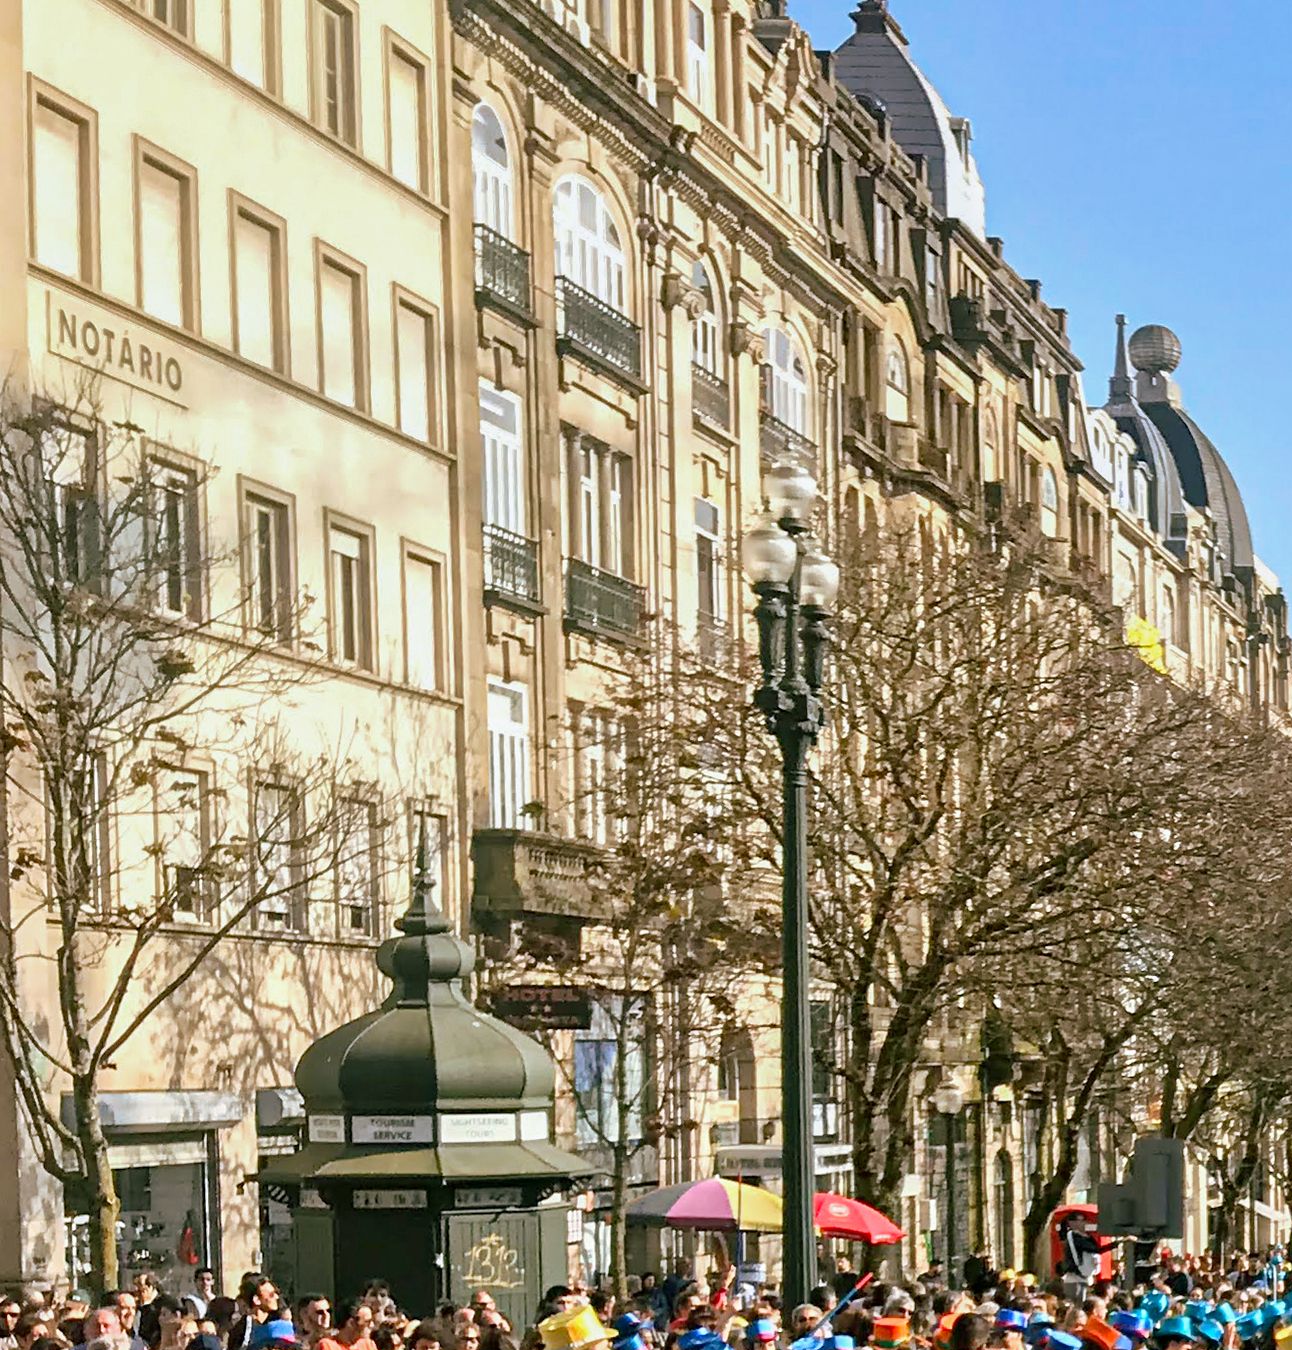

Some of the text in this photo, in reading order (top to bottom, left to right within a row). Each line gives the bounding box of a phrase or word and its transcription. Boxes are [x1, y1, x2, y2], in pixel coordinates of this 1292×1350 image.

[59, 308, 182, 391] NOTÁRIO
[370, 1118, 415, 1128] TOURISM
[373, 1131, 413, 1141] SERVICE
